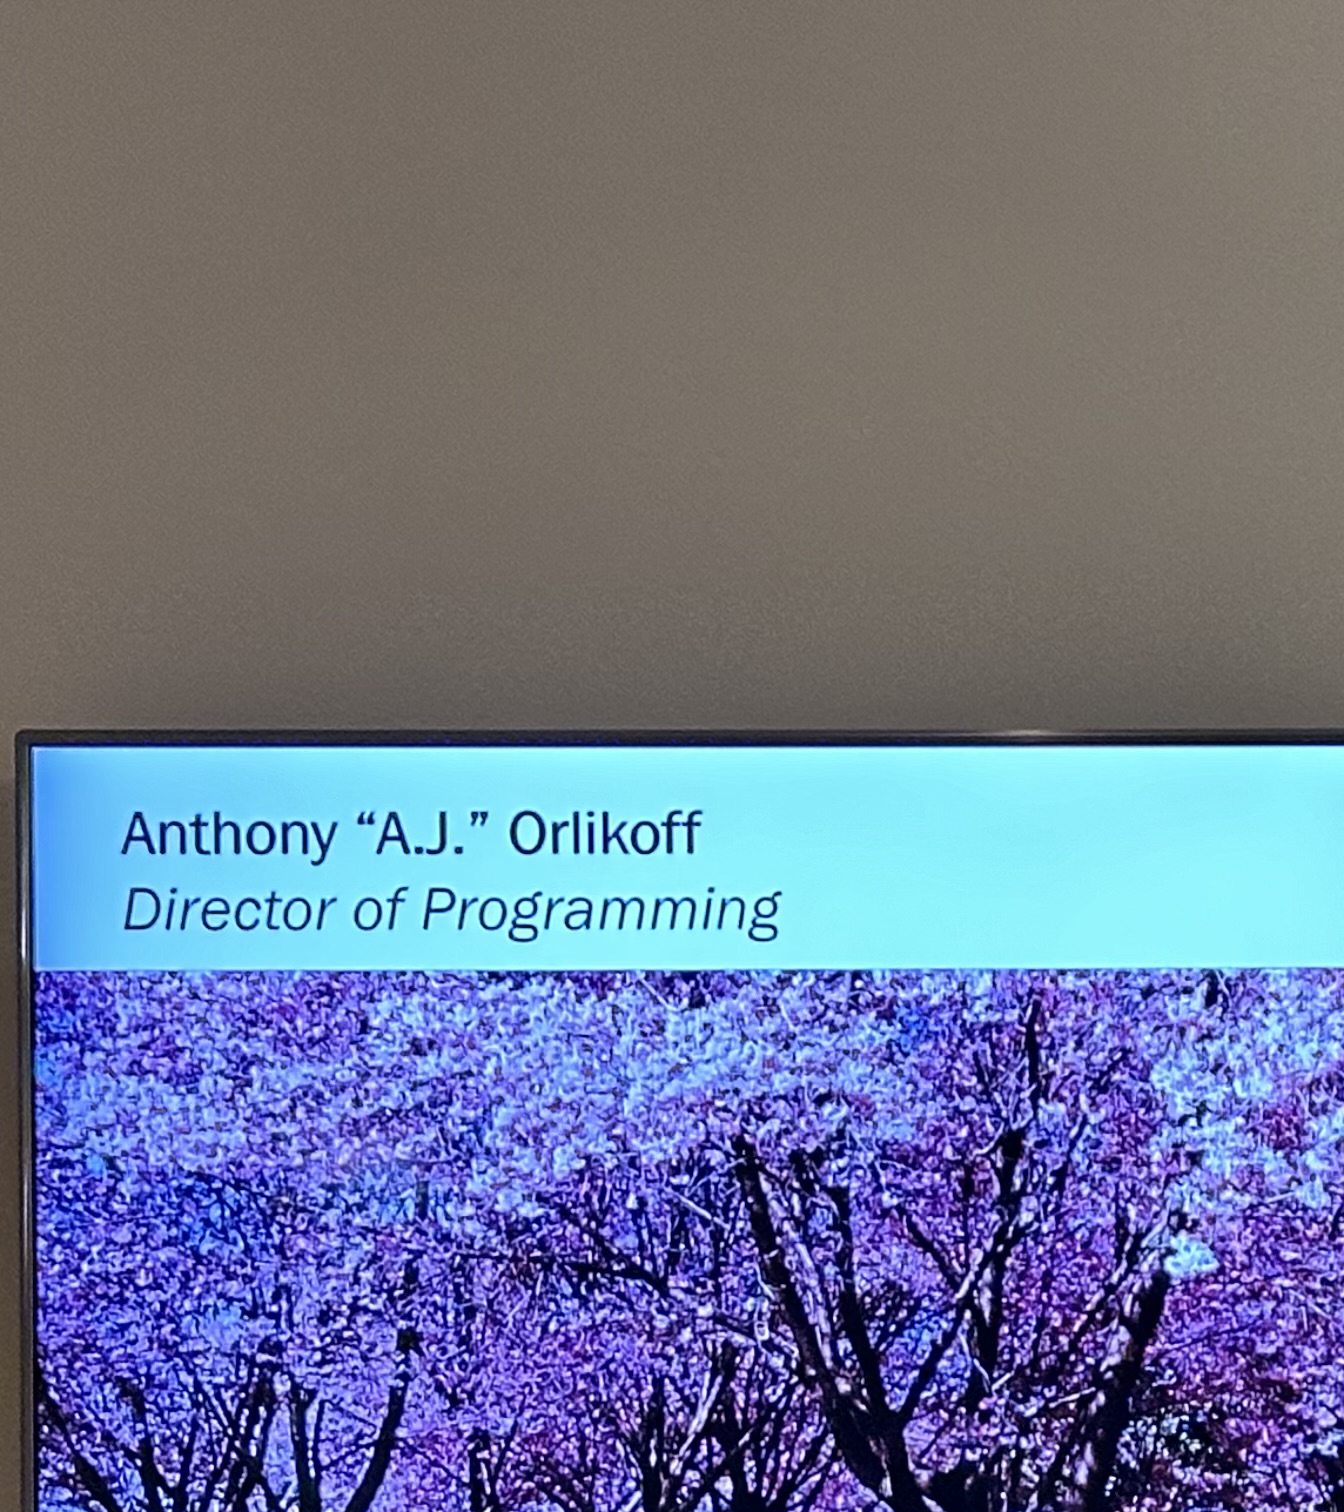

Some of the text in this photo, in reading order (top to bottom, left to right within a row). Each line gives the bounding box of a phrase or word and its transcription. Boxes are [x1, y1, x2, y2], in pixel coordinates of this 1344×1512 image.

[121, 809, 703, 867] Anthony “A.J.” Orlikoff
[124, 886, 783, 943] Director of Programming
